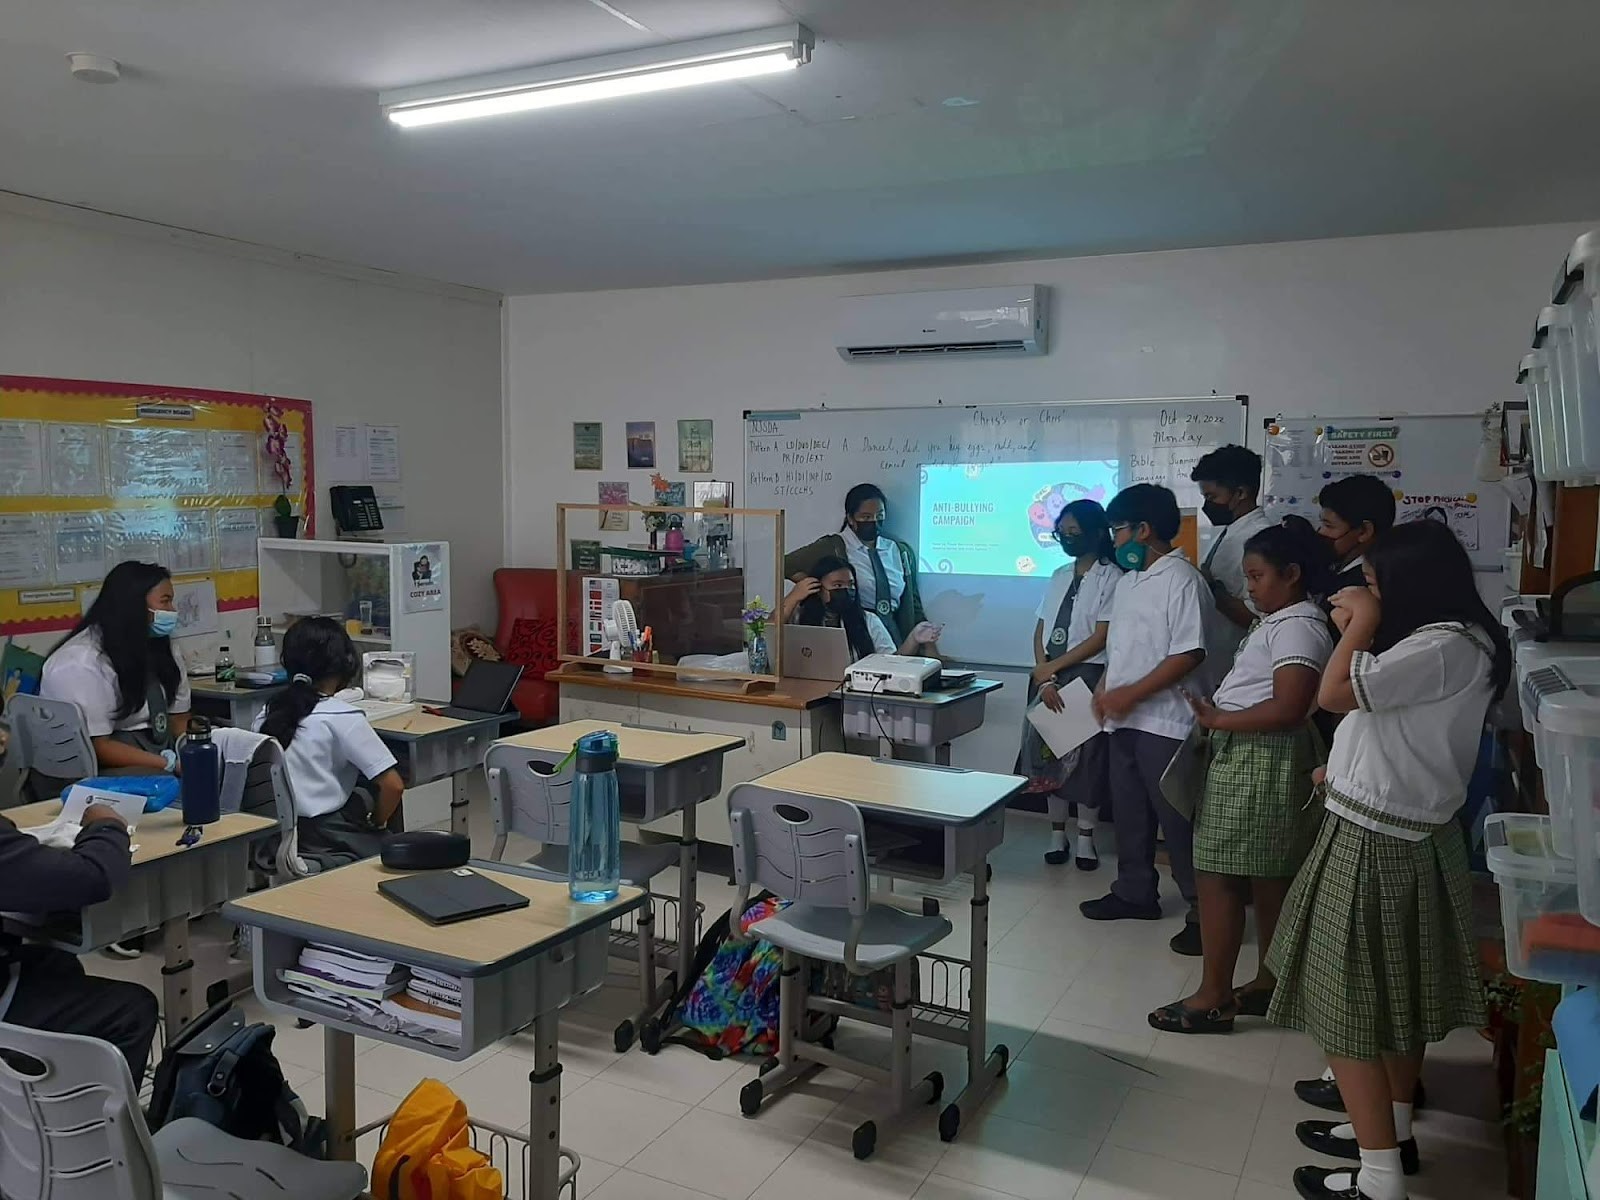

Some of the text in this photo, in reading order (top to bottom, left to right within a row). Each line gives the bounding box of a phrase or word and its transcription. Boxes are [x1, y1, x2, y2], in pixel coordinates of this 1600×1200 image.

[1153, 431, 1203, 448] Monday
[1331, 430, 1393, 439] SAFETY FIRST
[1402, 495, 1432, 505] STOP
[932, 502, 994, 513] ANTI-BULLYING
[932, 515, 975, 526] CAMPAIGN
